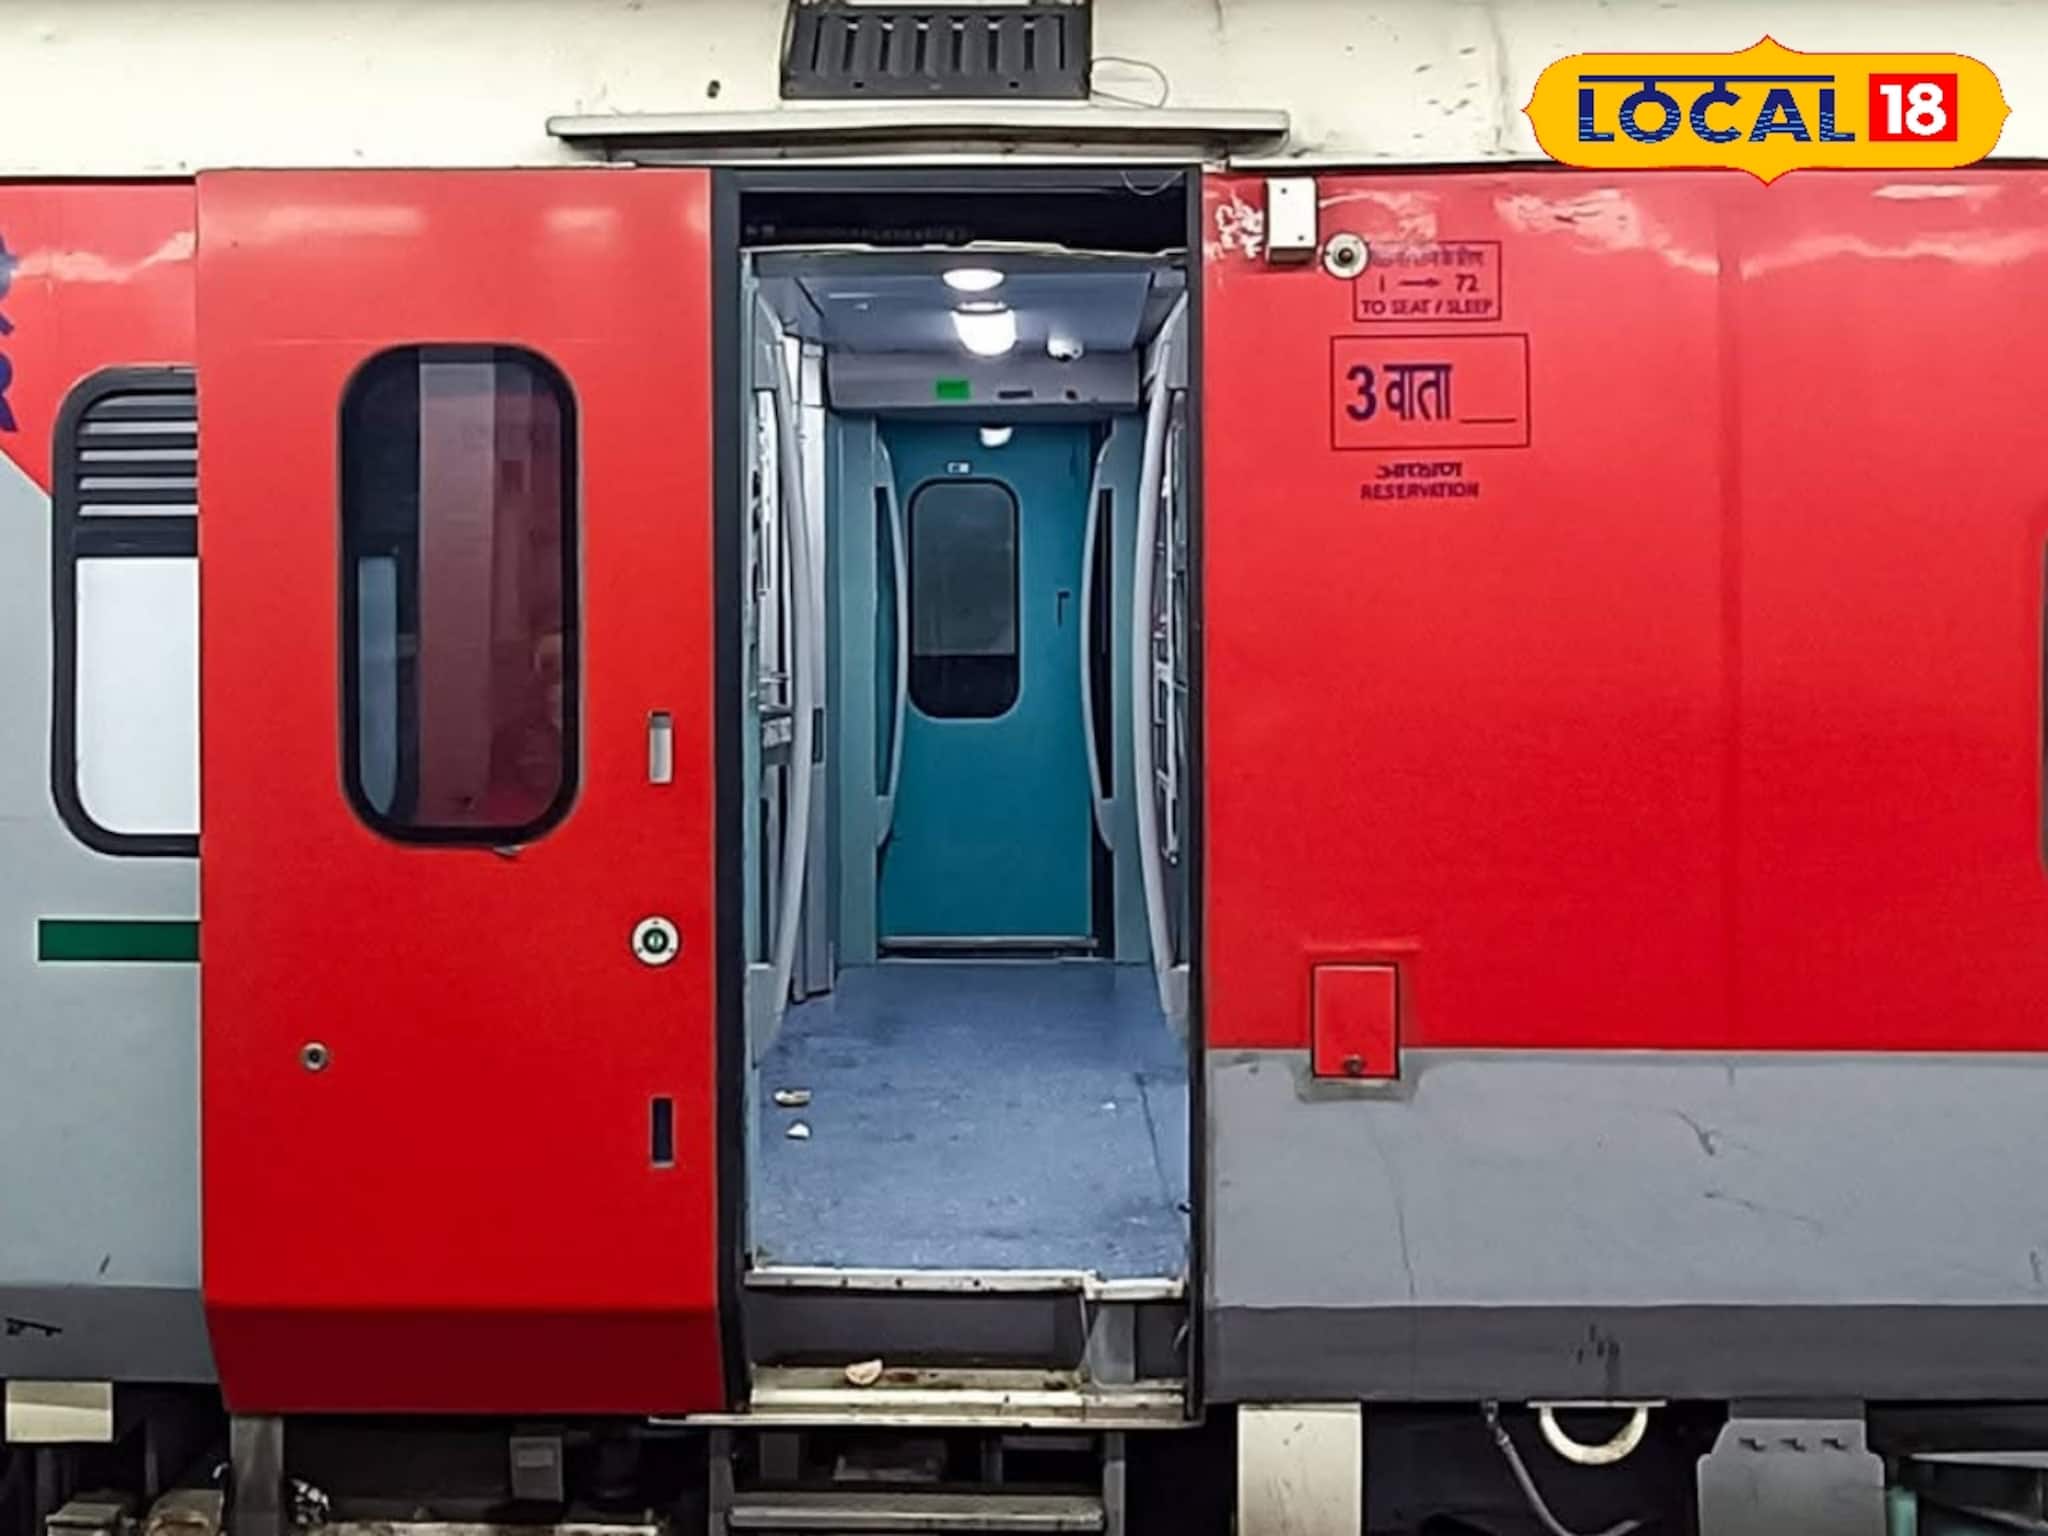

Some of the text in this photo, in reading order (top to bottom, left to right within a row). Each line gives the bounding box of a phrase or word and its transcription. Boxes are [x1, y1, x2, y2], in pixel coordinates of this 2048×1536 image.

[1456, 273, 1479, 293] 72
[1361, 300, 1386, 314] TO
[1391, 300, 1431, 315] SEAT
[1360, 482, 1479, 499] RESERVATION
